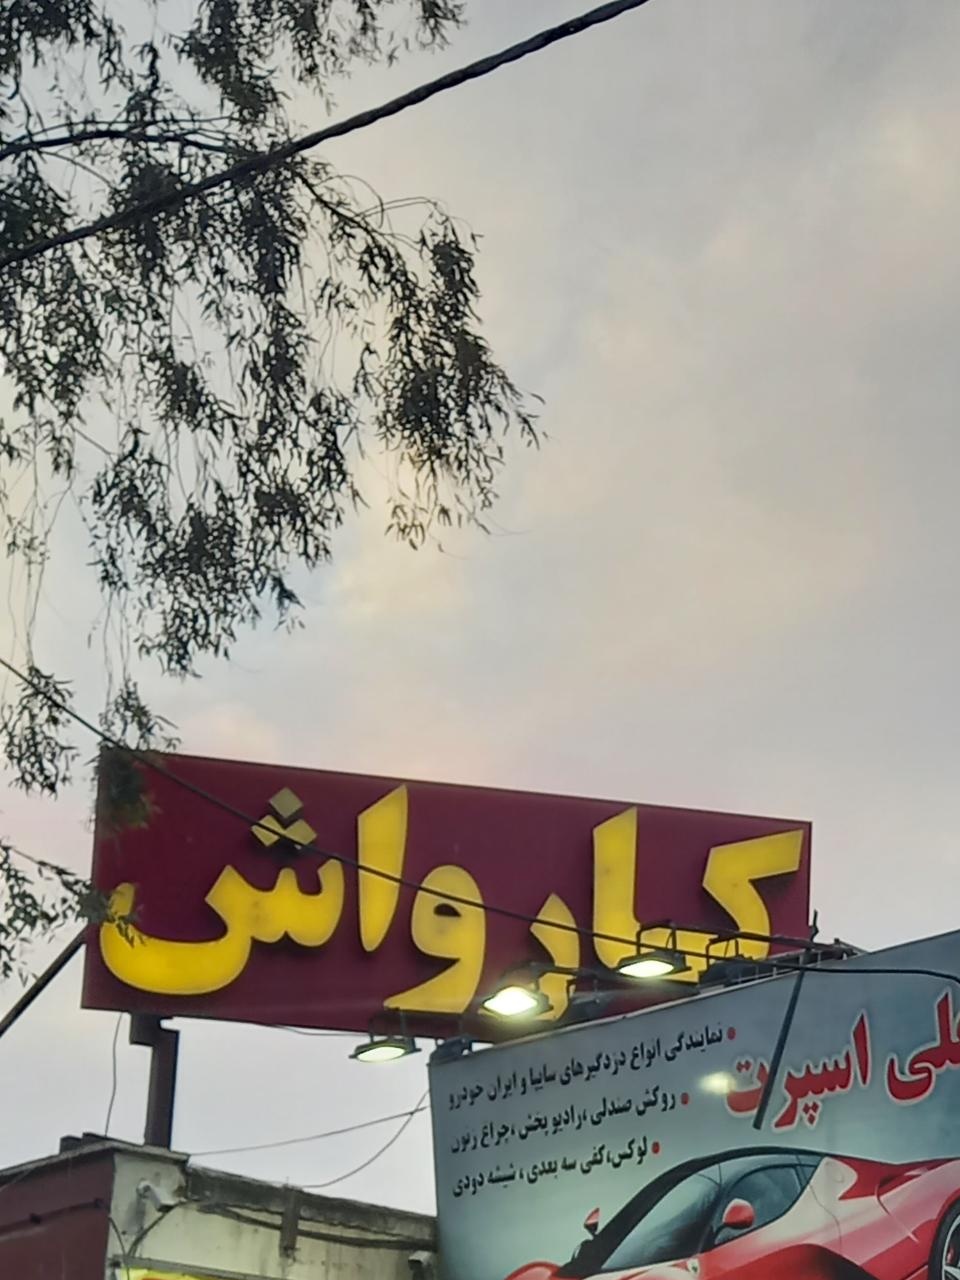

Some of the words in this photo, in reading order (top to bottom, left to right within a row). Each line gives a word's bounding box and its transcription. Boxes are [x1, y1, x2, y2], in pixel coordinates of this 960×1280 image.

[630, 1038, 662, 1071] انواع
[664, 1025, 724, 1062] نمایندگی
[529, 1063, 556, 1092] سایپا
[725, 1011, 869, 1131] اسپرت
[448, 1083, 485, 1112] خودرو
[487, 1072, 518, 1101] ایران
[635, 1085, 676, 1117] روکش
[591, 1096, 632, 1126] صندلی
[527, 1157, 558, 1186] بعدی
[561, 1156, 577, 1173] سه
[452, 1170, 485, 1198] دودی
